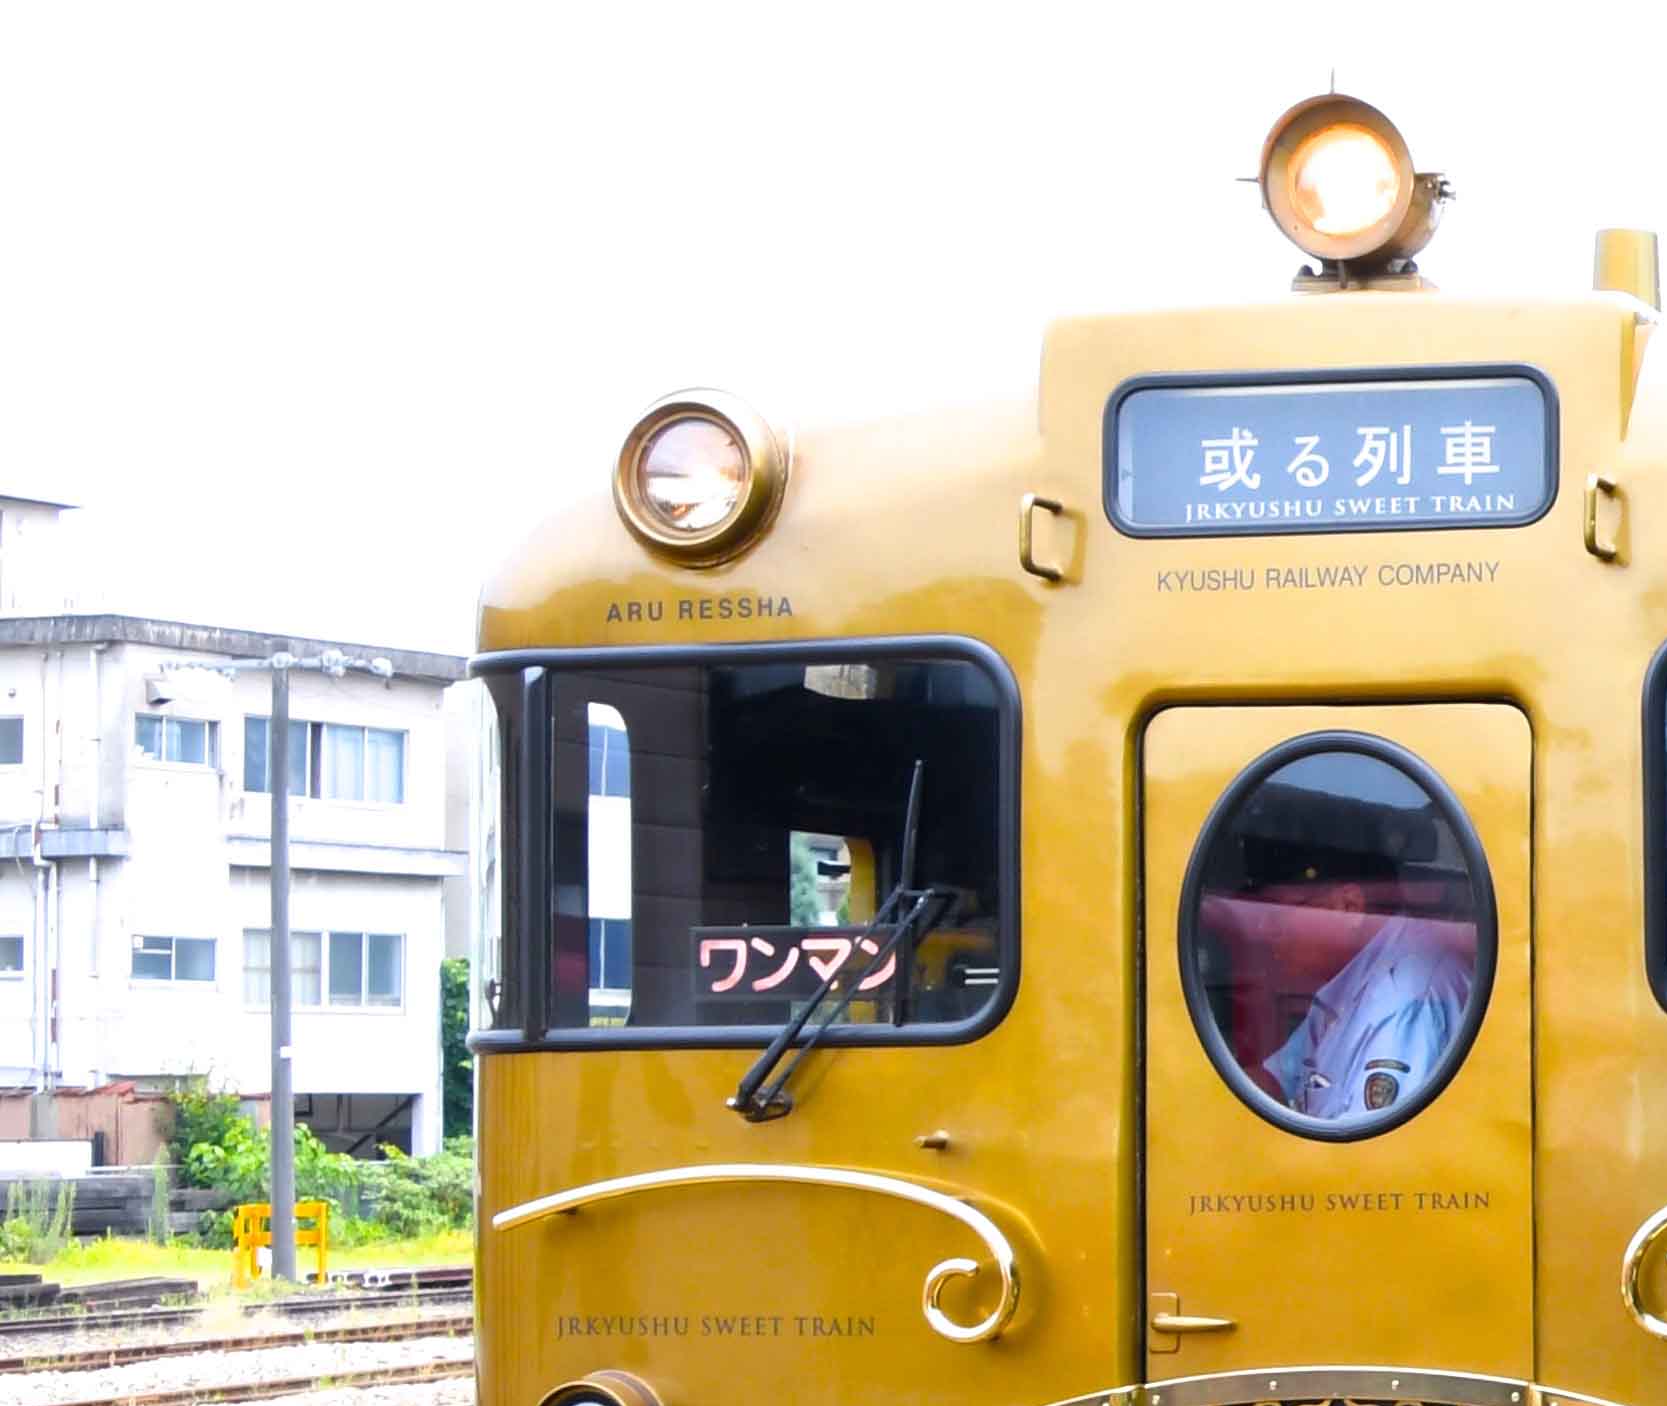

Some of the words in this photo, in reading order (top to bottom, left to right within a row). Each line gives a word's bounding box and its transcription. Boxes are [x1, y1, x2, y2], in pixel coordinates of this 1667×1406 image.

[1199, 421, 1500, 492] 或る列車
[1185, 498, 1323, 523] JRKYUSHU
[1334, 495, 1421, 516] SWEET
[1432, 493, 1516, 514] TRAIN
[1156, 569, 1255, 593] KYUSHU
[1265, 566, 1369, 590] RAILWAY
[1377, 561, 1500, 588] COMPANY
[606, 600, 664, 623] ARU
[678, 596, 794, 620] RESSHA
[700, 936, 897, 992] ワンマン
[1188, 1195, 1316, 1216] JRKYUSHU
[1326, 1192, 1404, 1211] SWEET
[1414, 1191, 1490, 1210] TRAIN
[557, 1314, 690, 1341] JRKYUSHU
[700, 1314, 784, 1337] SWEET
[793, 1315, 876, 1337] TRAIN
